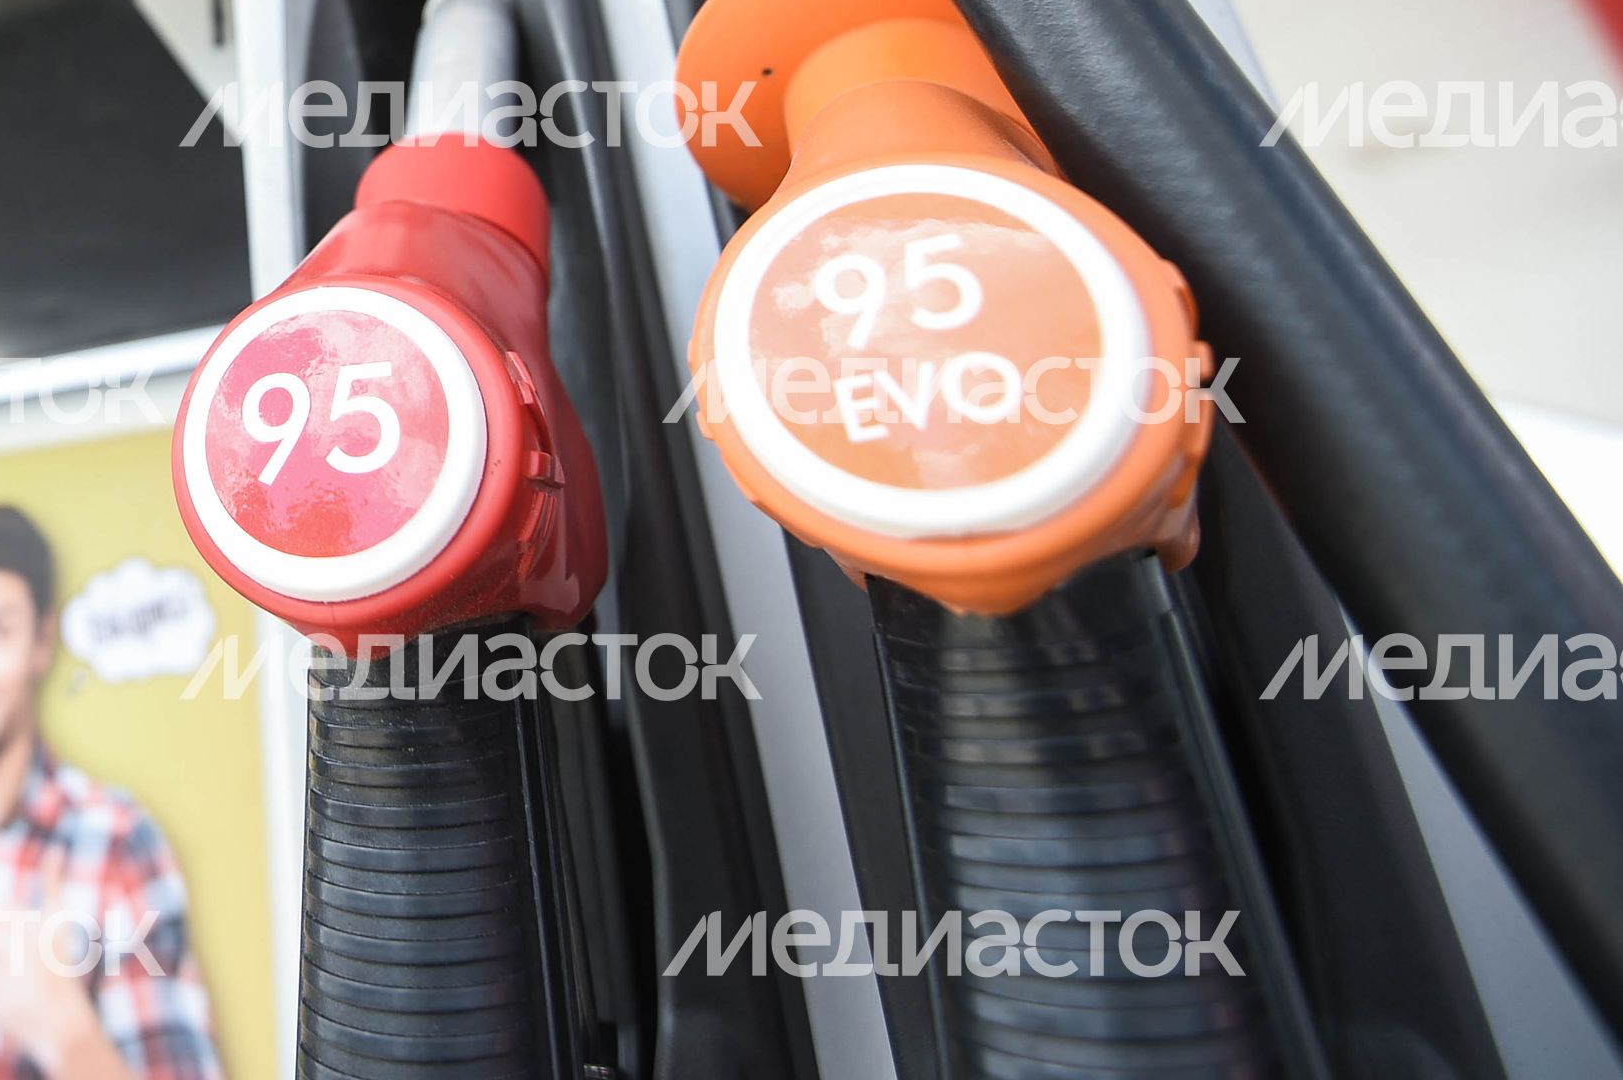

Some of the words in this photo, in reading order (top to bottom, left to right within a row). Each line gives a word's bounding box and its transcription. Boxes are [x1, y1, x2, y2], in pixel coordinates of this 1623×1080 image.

[814, 232, 984, 351] 95
[241, 360, 401, 487] 95
[834, 350, 1022, 443] EVO
